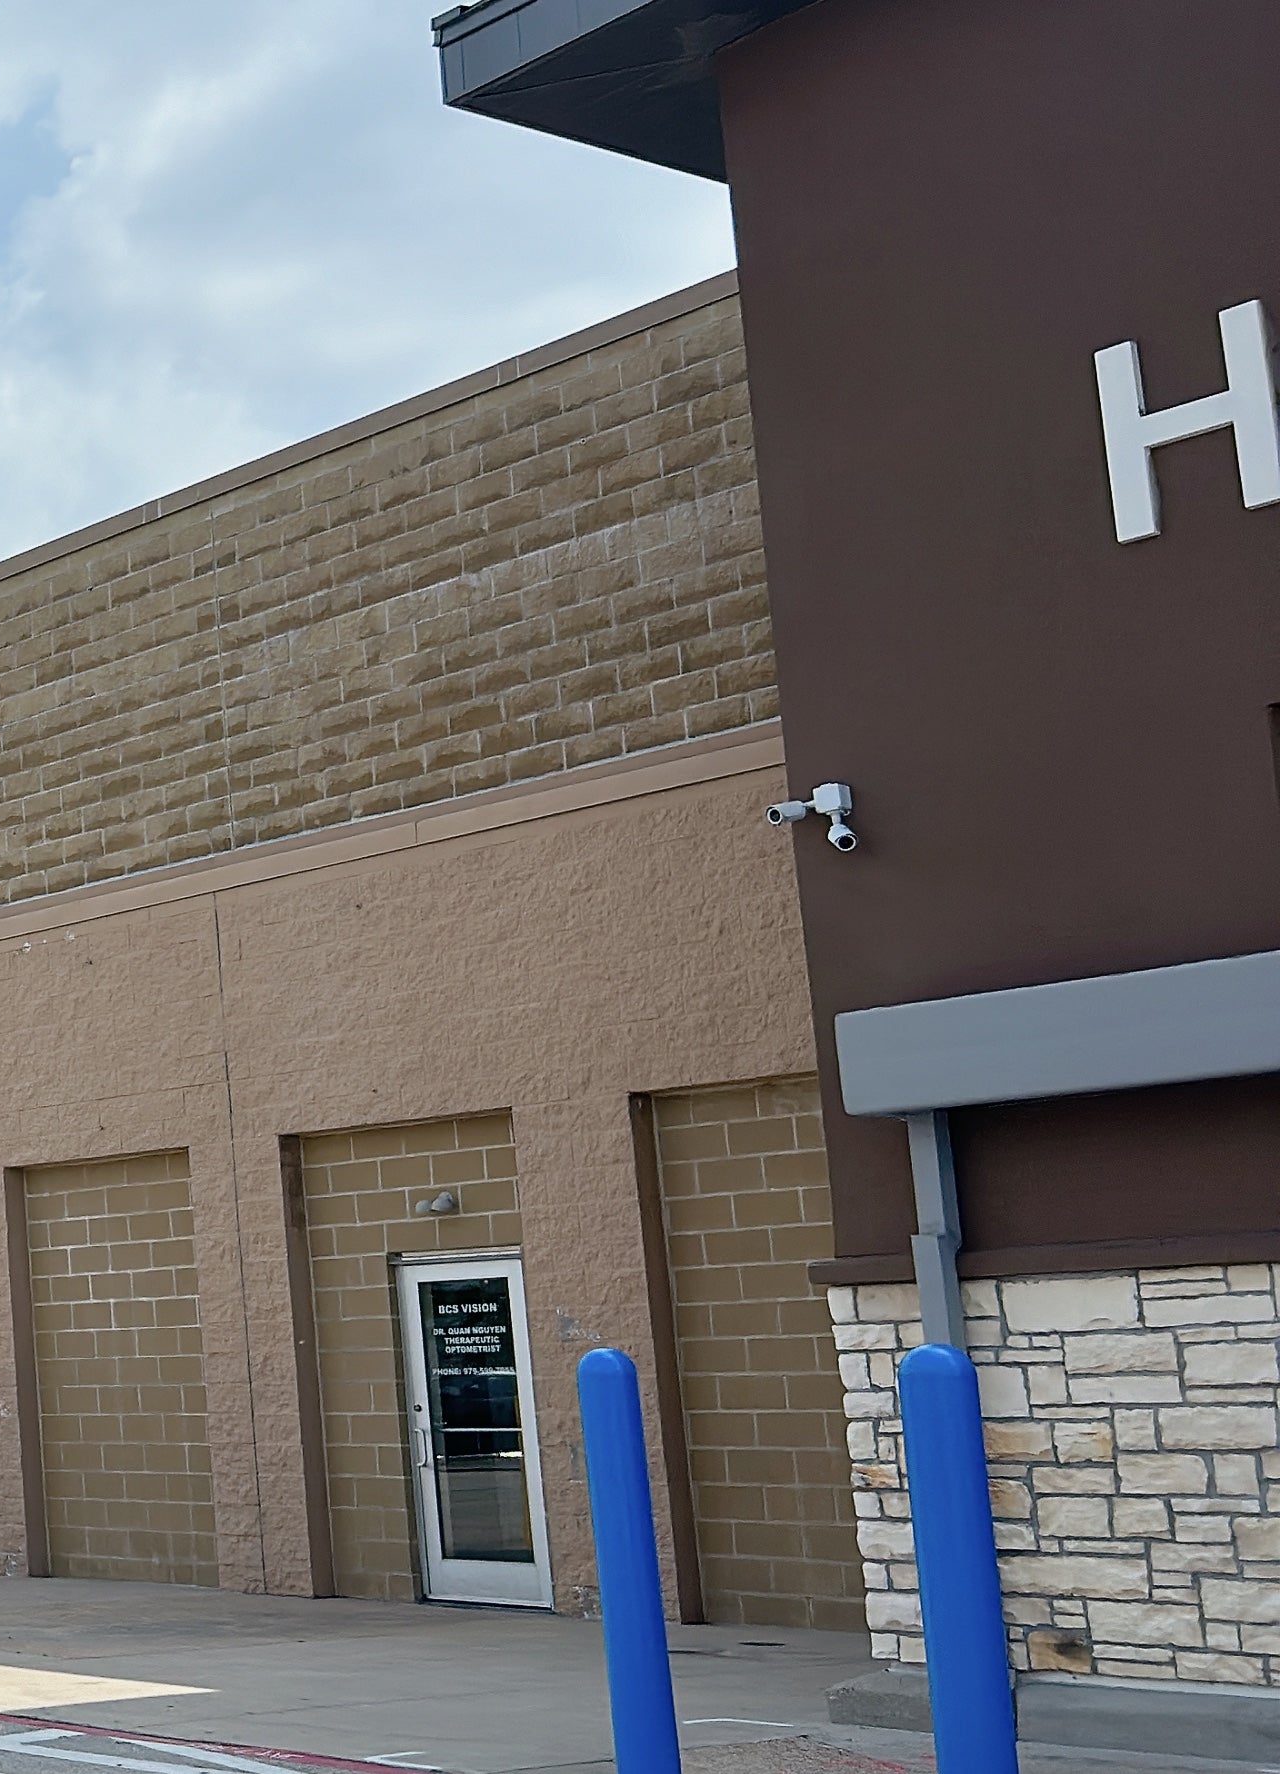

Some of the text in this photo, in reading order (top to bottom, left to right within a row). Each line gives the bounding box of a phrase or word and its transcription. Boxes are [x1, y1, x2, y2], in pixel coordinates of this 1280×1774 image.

[438, 1303, 497, 1314] BCS VISION
[433, 1326, 506, 1336] DR. QUAN NGUYEN
[444, 1335, 500, 1345] THERAPEUTIC
[445, 1344, 501, 1354] OPTOMETRIST
[432, 1367, 462, 1376] PHONE:
